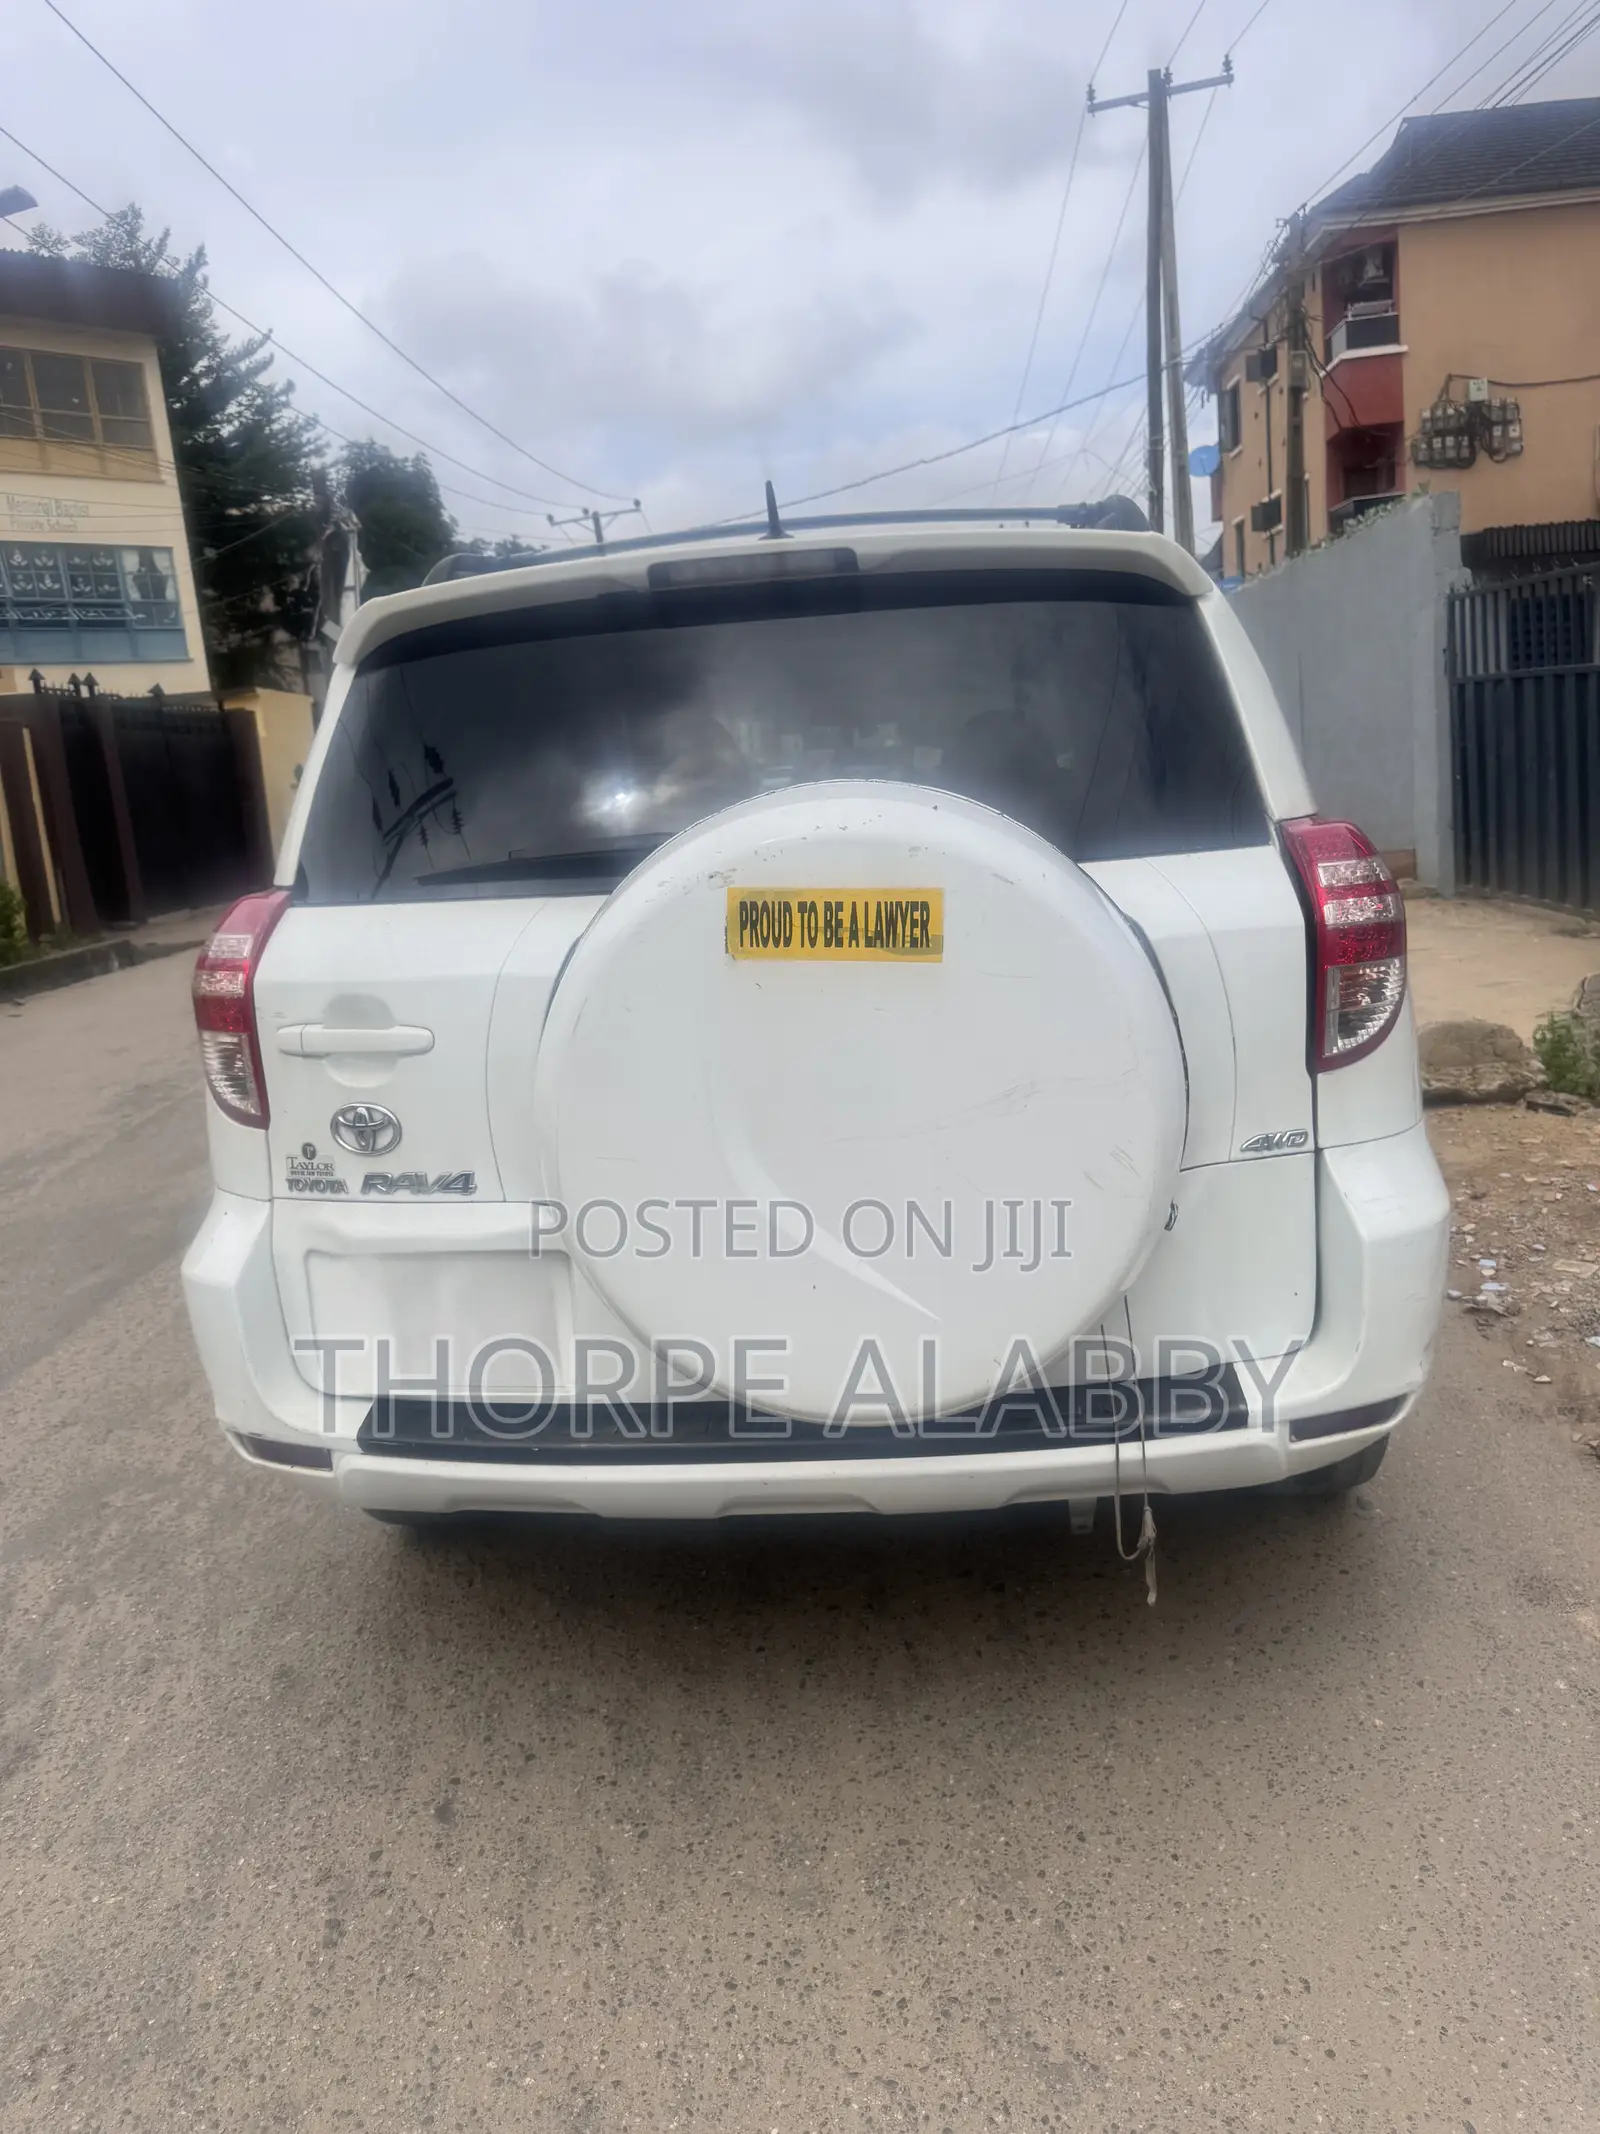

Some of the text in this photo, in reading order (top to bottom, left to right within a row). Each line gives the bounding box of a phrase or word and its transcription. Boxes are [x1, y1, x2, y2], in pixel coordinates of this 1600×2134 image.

[739, 900, 931, 948] PROUD TO BE A LAWYER
[1240, 1128, 1309, 1152] 4WD
[285, 1178, 349, 1194] TOYOTA
[361, 1170, 477, 1196] RAV4
